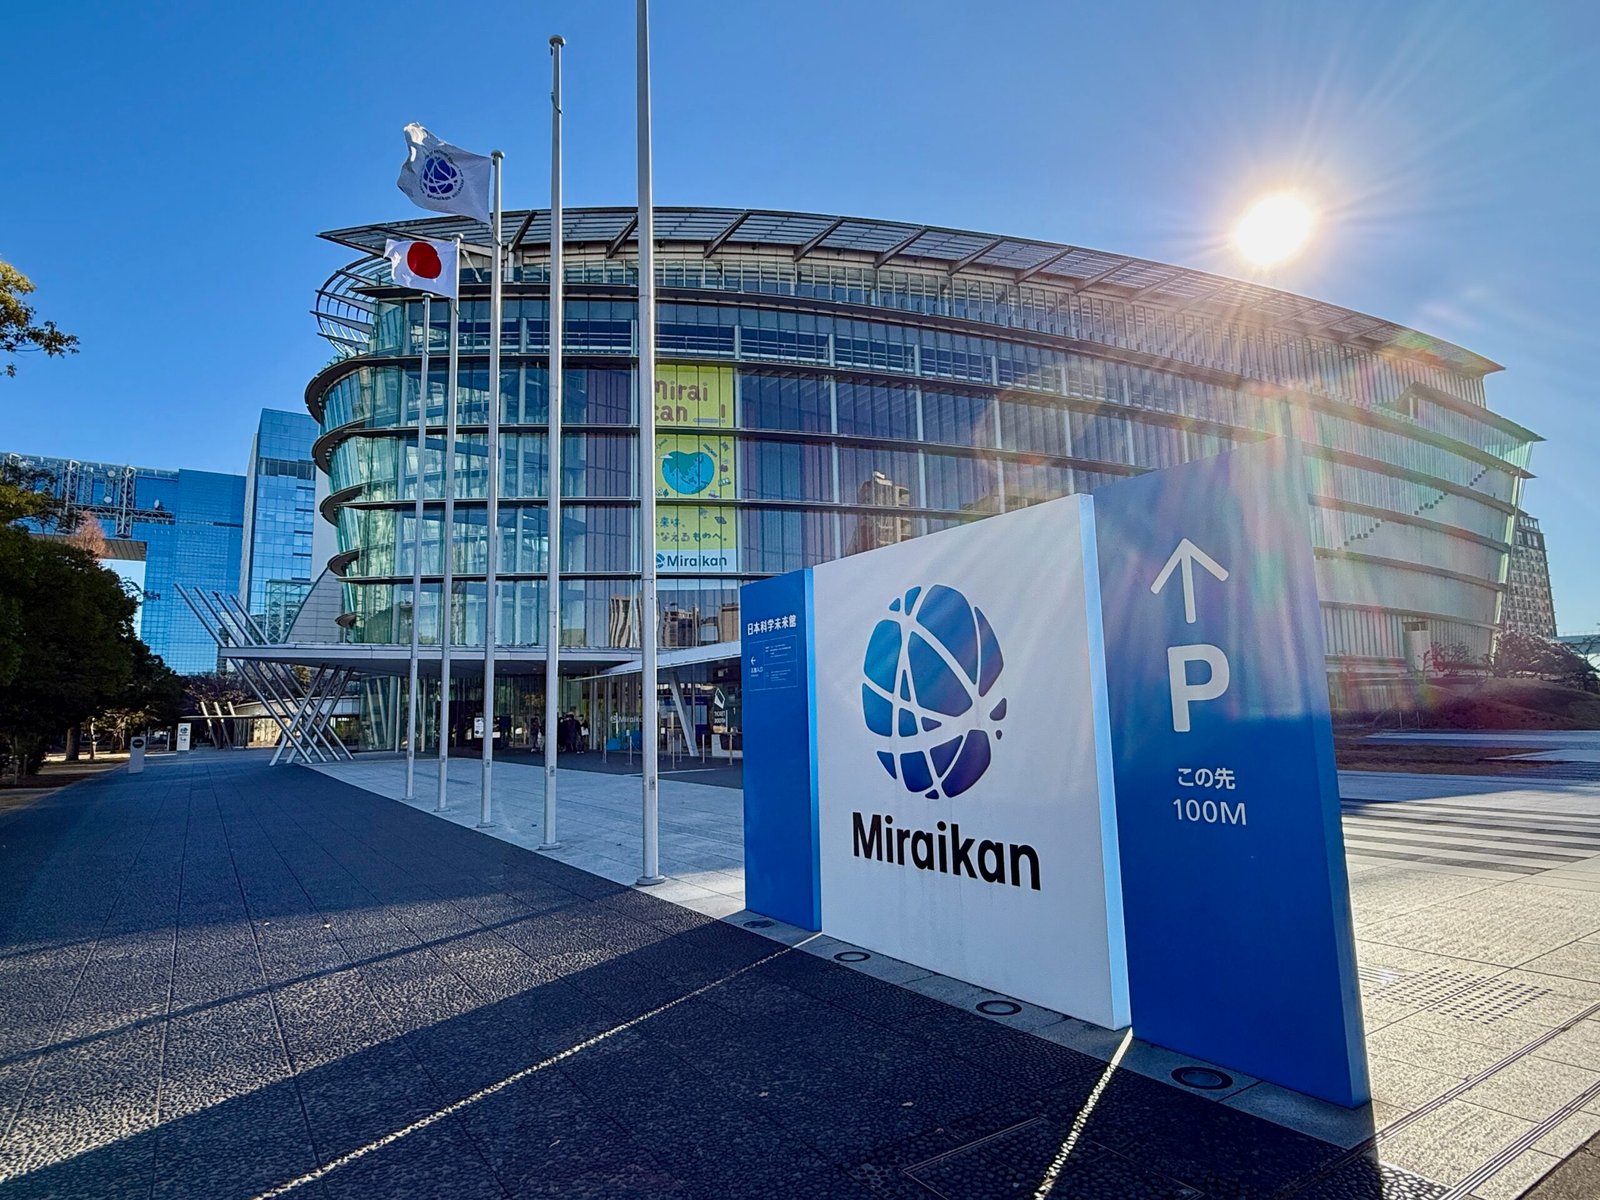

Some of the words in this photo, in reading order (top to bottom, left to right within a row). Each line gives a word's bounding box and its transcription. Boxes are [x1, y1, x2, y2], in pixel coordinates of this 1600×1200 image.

[656, 516, 686, 528] 来は、
[656, 532, 728, 542] なえるものへ。
[667, 555, 727, 566] Miraikan
[747, 614, 797, 636] 日本科学未来館
[1167, 644, 1231, 733] P
[1177, 767, 1236, 790] この先
[1173, 798, 1247, 826] 100M
[852, 811, 1041, 891] Miraikan
